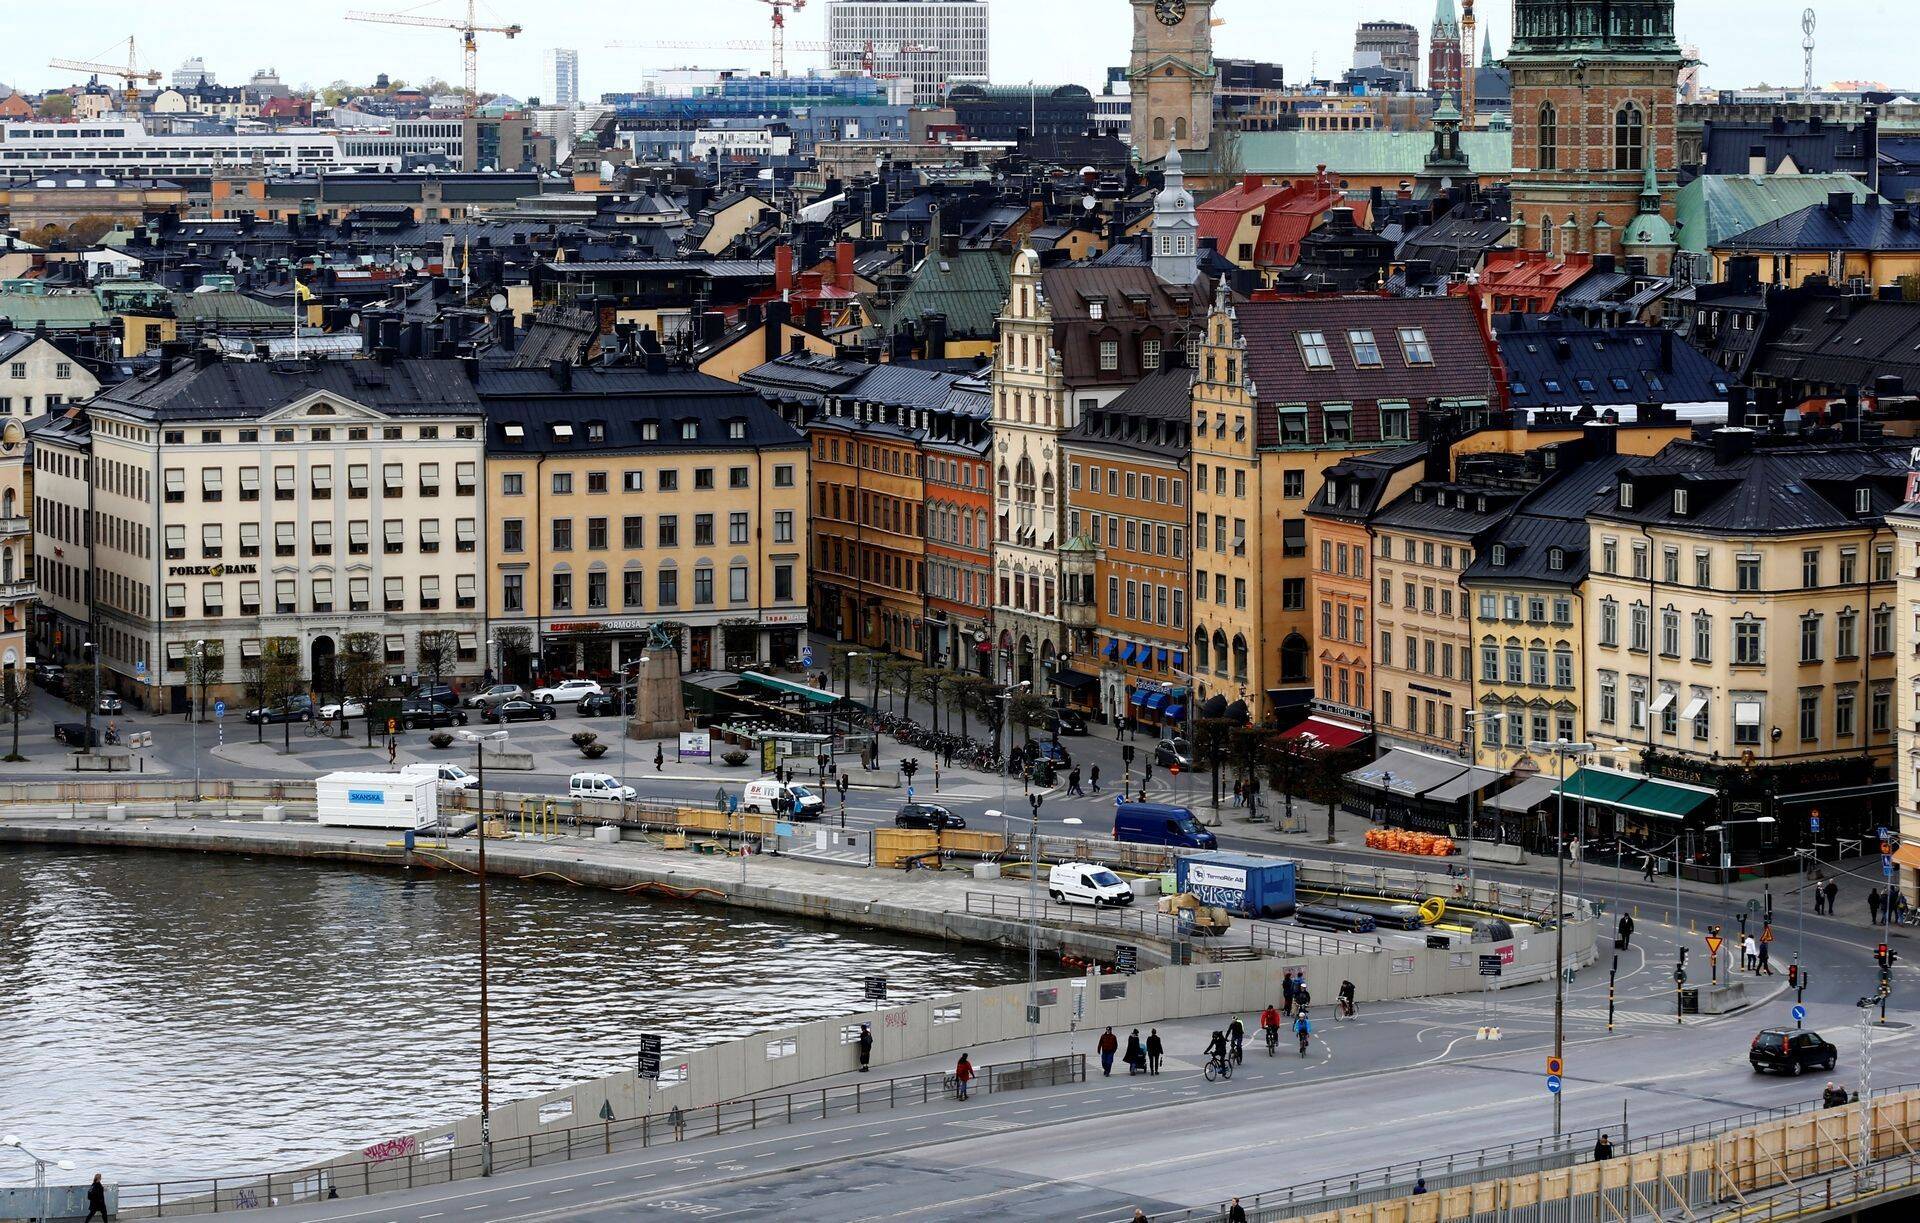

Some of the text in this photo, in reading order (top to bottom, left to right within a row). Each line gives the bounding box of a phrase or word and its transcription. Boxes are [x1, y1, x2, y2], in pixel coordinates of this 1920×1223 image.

[169, 564, 257, 576] FOREX BANK
[1661, 767, 1701, 782] ENGELEN
[351, 793, 381, 801] SKANSKA
